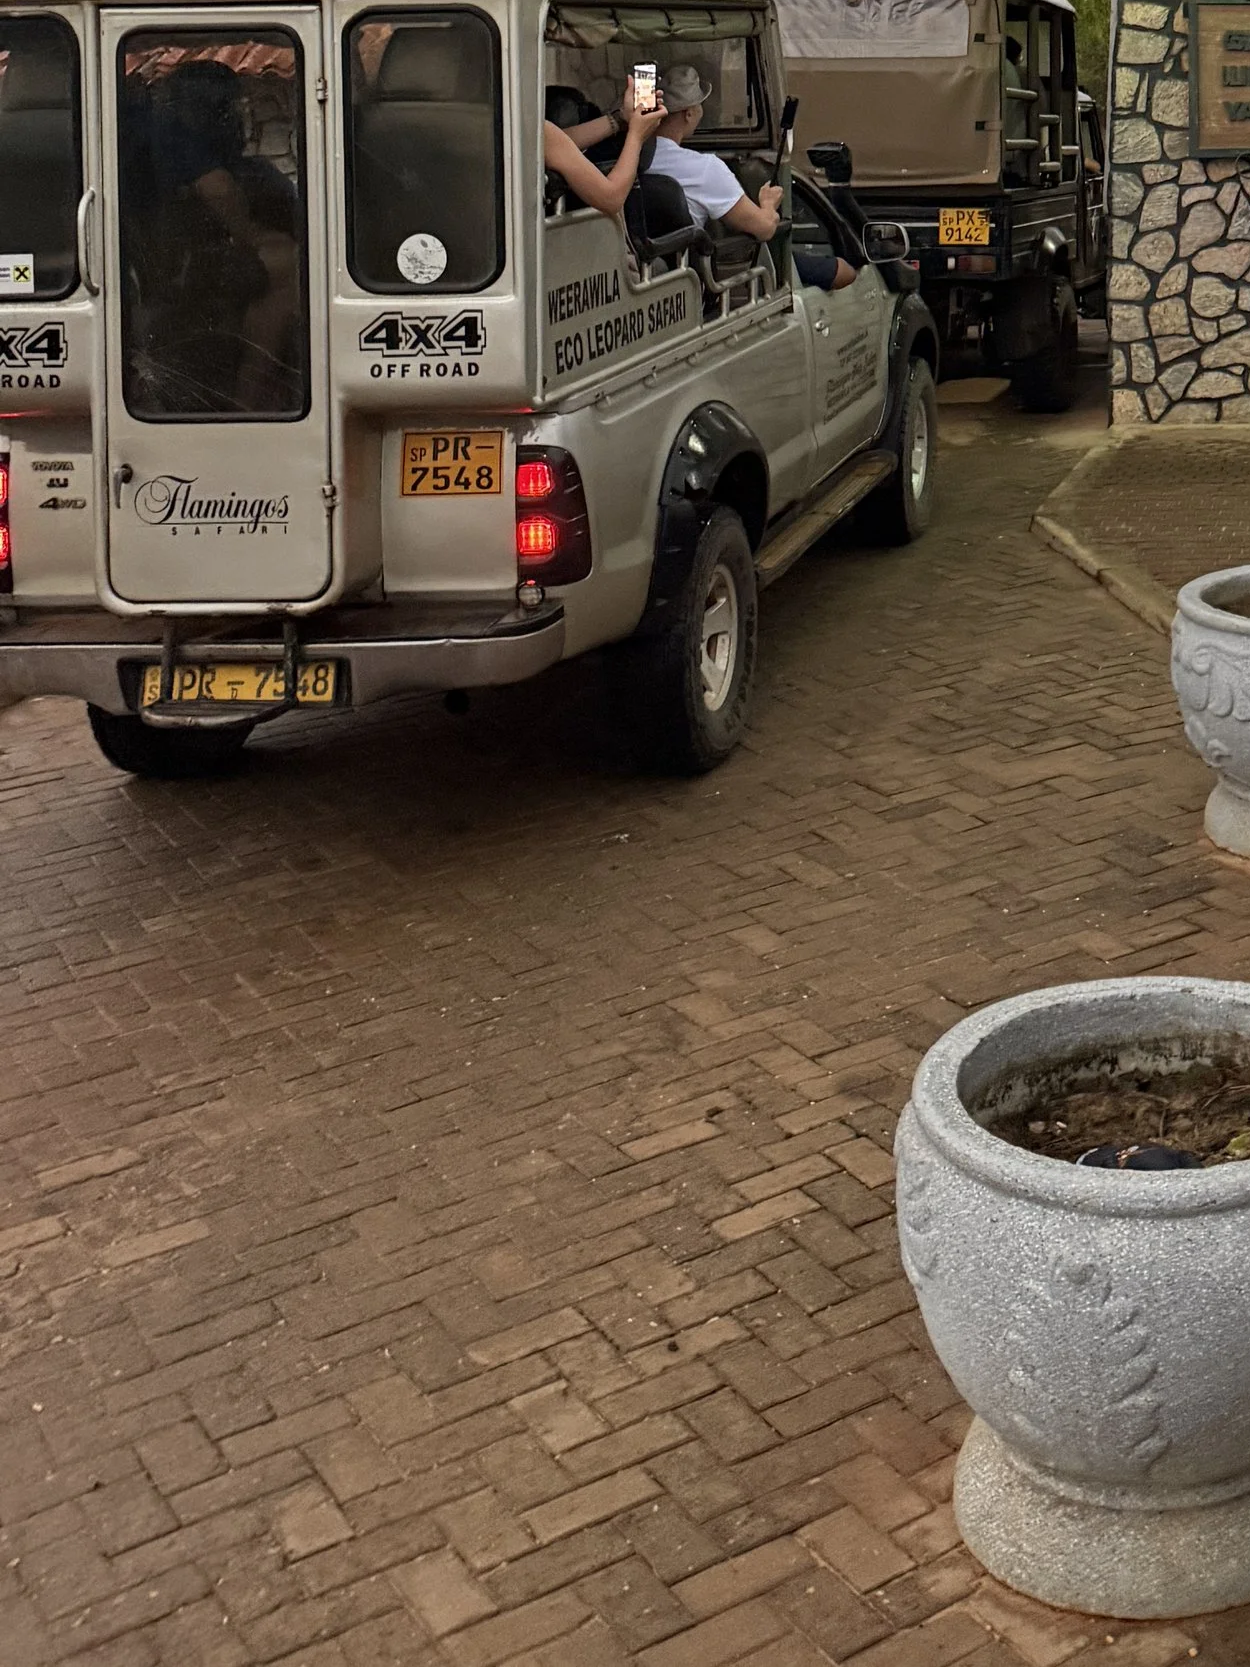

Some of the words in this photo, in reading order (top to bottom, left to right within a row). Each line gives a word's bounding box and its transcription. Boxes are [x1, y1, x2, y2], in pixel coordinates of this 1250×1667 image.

[945, 227, 983, 242] 9142
[548, 269, 621, 326] WEERAWILA
[555, 333, 584, 375] ECO
[587, 308, 644, 361] LEOPARD
[648, 290, 686, 334] SAFARI
[370, 363, 411, 378] OFF
[420, 362, 480, 377] ROAD
[2, 374, 61, 388] ROAD
[410, 447, 427, 463] SP
[410, 465, 494, 492] 7548
[134, 475, 291, 533] Flamingos
